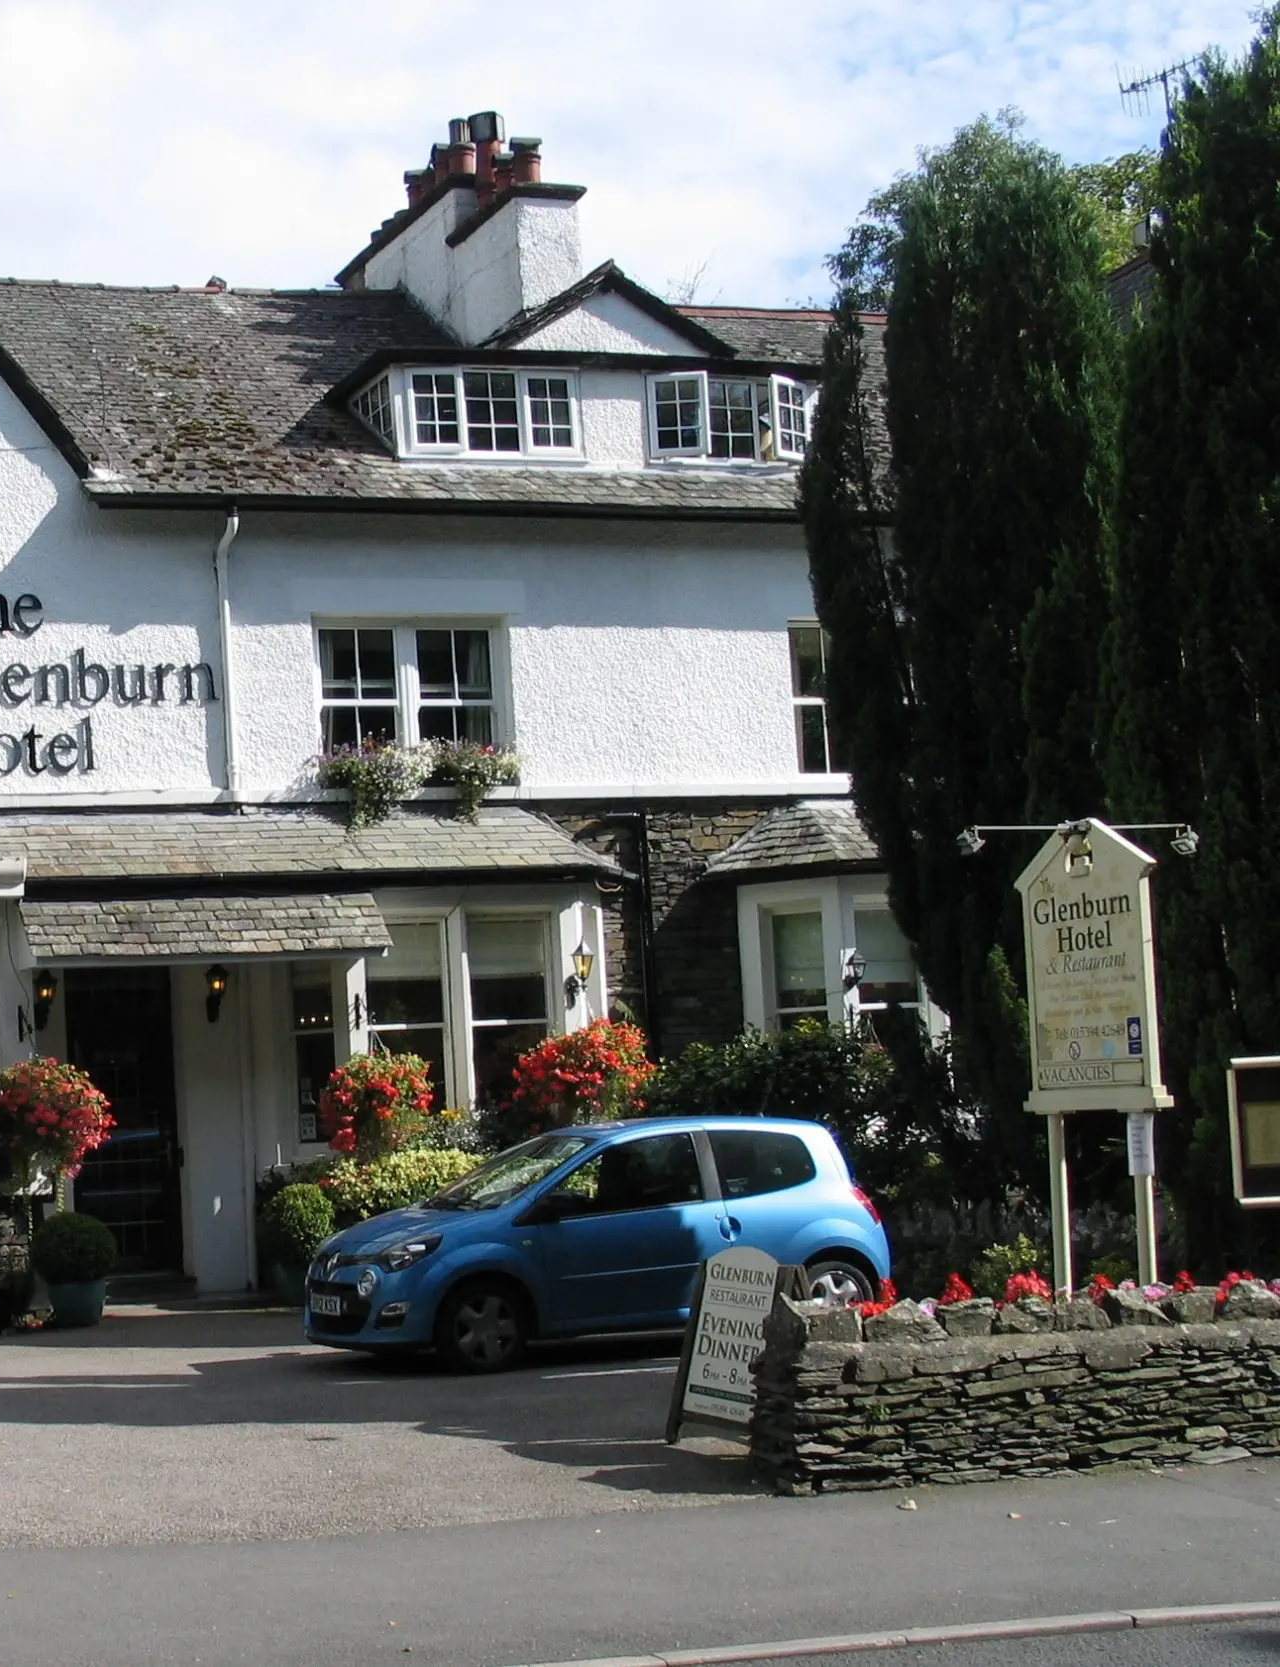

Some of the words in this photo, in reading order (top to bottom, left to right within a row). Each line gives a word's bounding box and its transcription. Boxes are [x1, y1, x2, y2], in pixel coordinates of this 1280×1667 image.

[1033, 892, 1131, 925] Glenburn
[1056, 920, 1113, 953] Hotel
[1045, 959, 1058, 975] &
[1063, 952, 1126, 973] Restaurant
[1043, 1065, 1111, 1083] VACANCIES
[711, 1262, 775, 1286] GLENBURN
[710, 1288, 768, 1307] RESTAURANT
